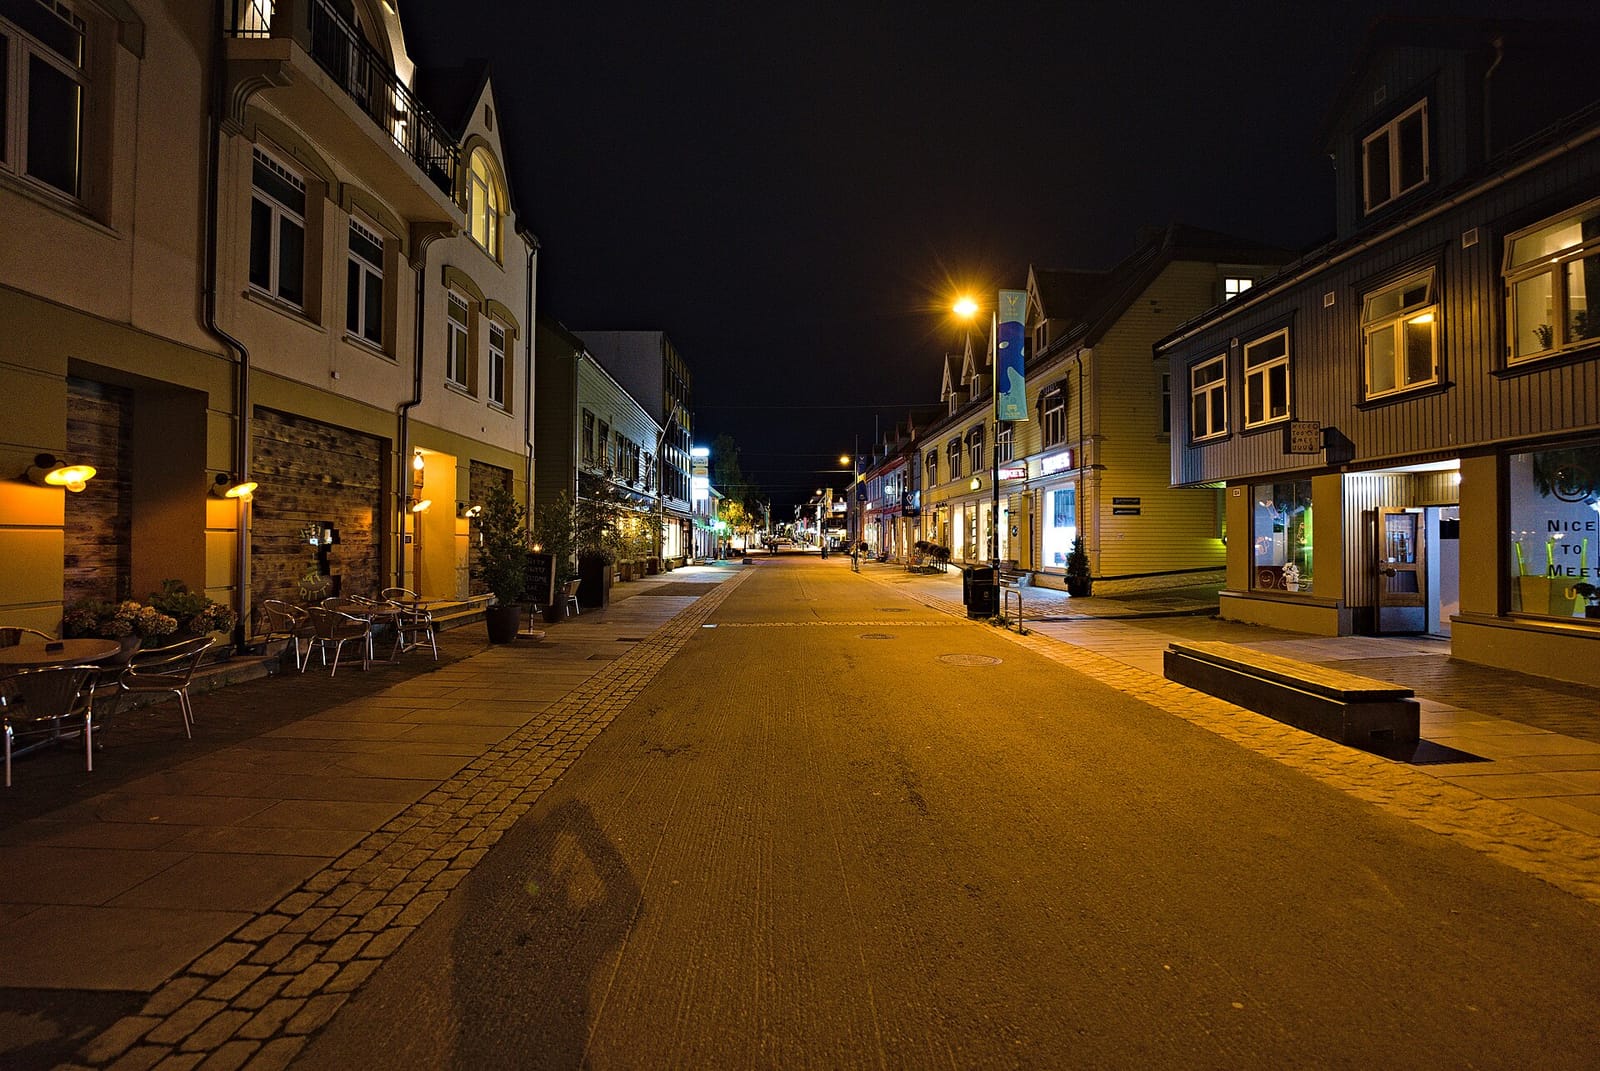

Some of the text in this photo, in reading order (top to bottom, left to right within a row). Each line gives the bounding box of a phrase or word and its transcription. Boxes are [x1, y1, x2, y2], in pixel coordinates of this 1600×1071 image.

[1547, 519, 1596, 532] NICE
[1561, 544, 1582, 555] TO
[1564, 587, 1577, 600] U
